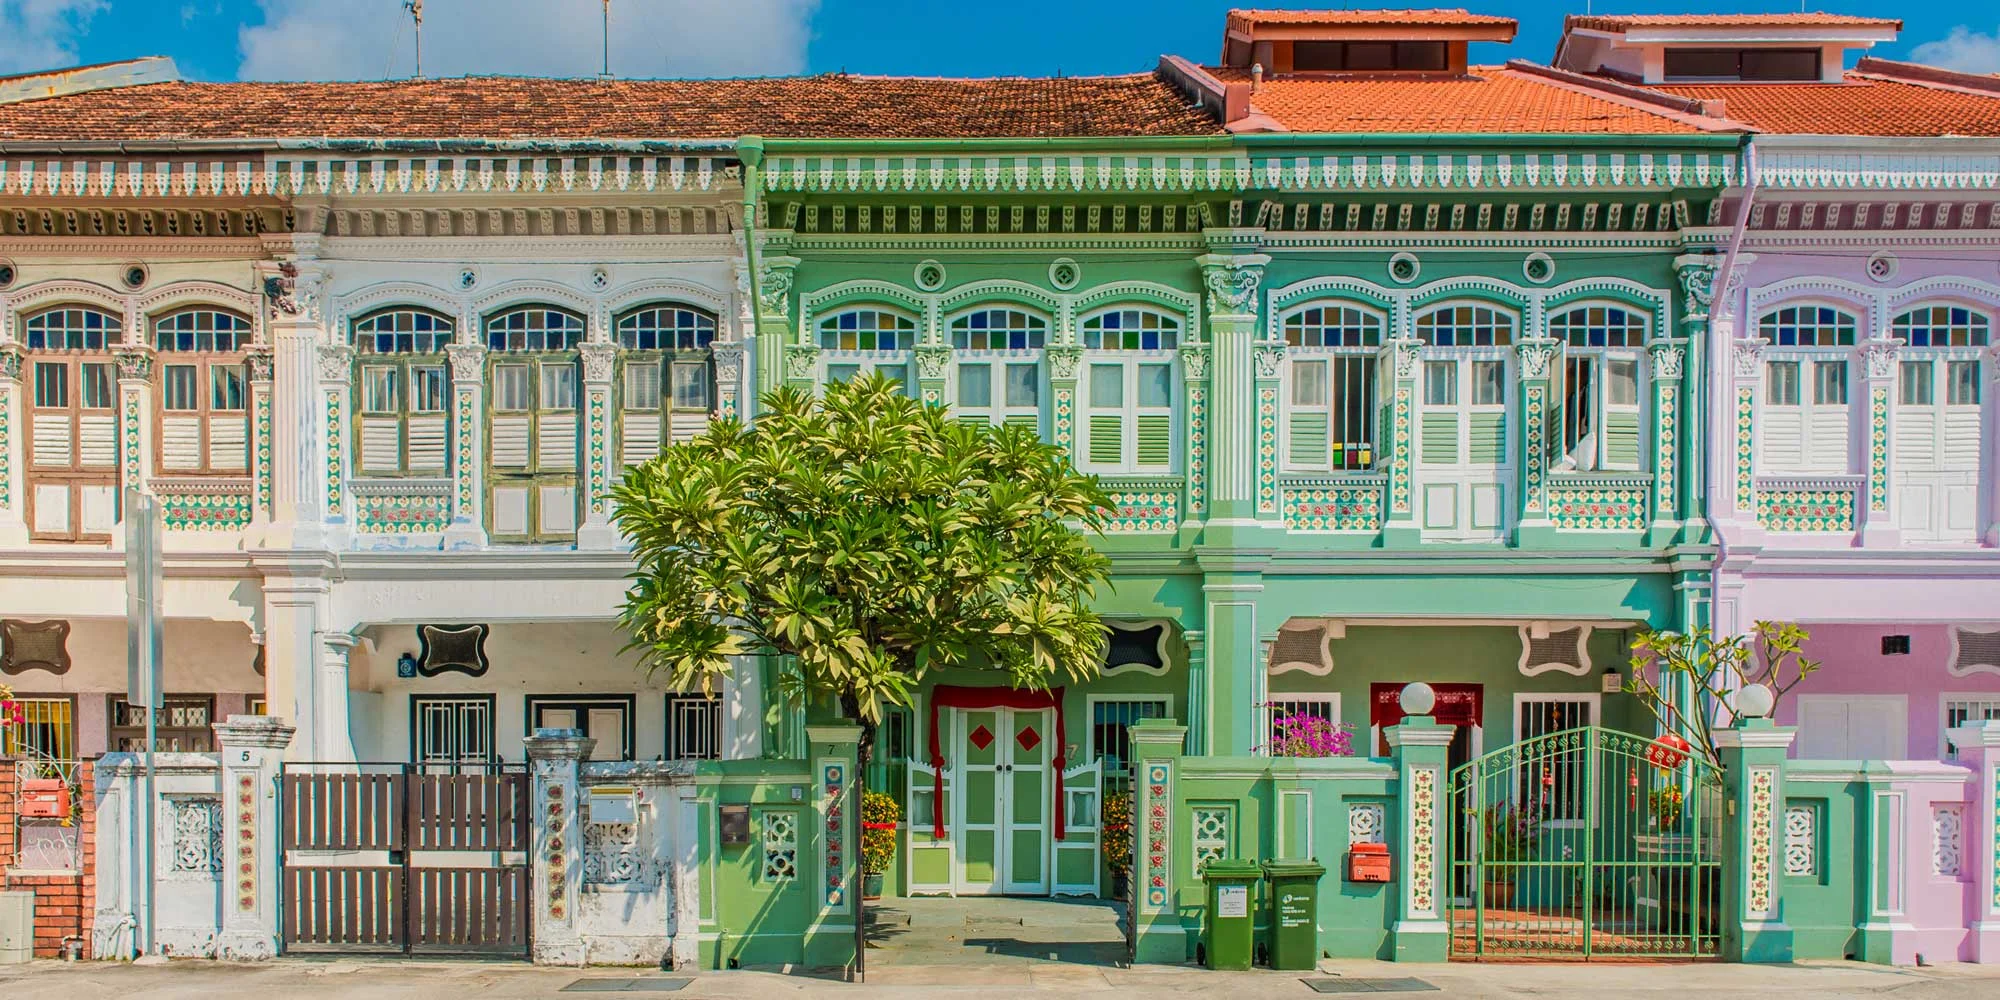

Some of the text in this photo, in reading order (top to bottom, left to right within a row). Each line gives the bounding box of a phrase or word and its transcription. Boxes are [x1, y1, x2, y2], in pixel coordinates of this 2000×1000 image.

[828, 744, 836, 755] 7
[1066, 744, 1078, 759] 7
[242, 751, 250, 761] 5
